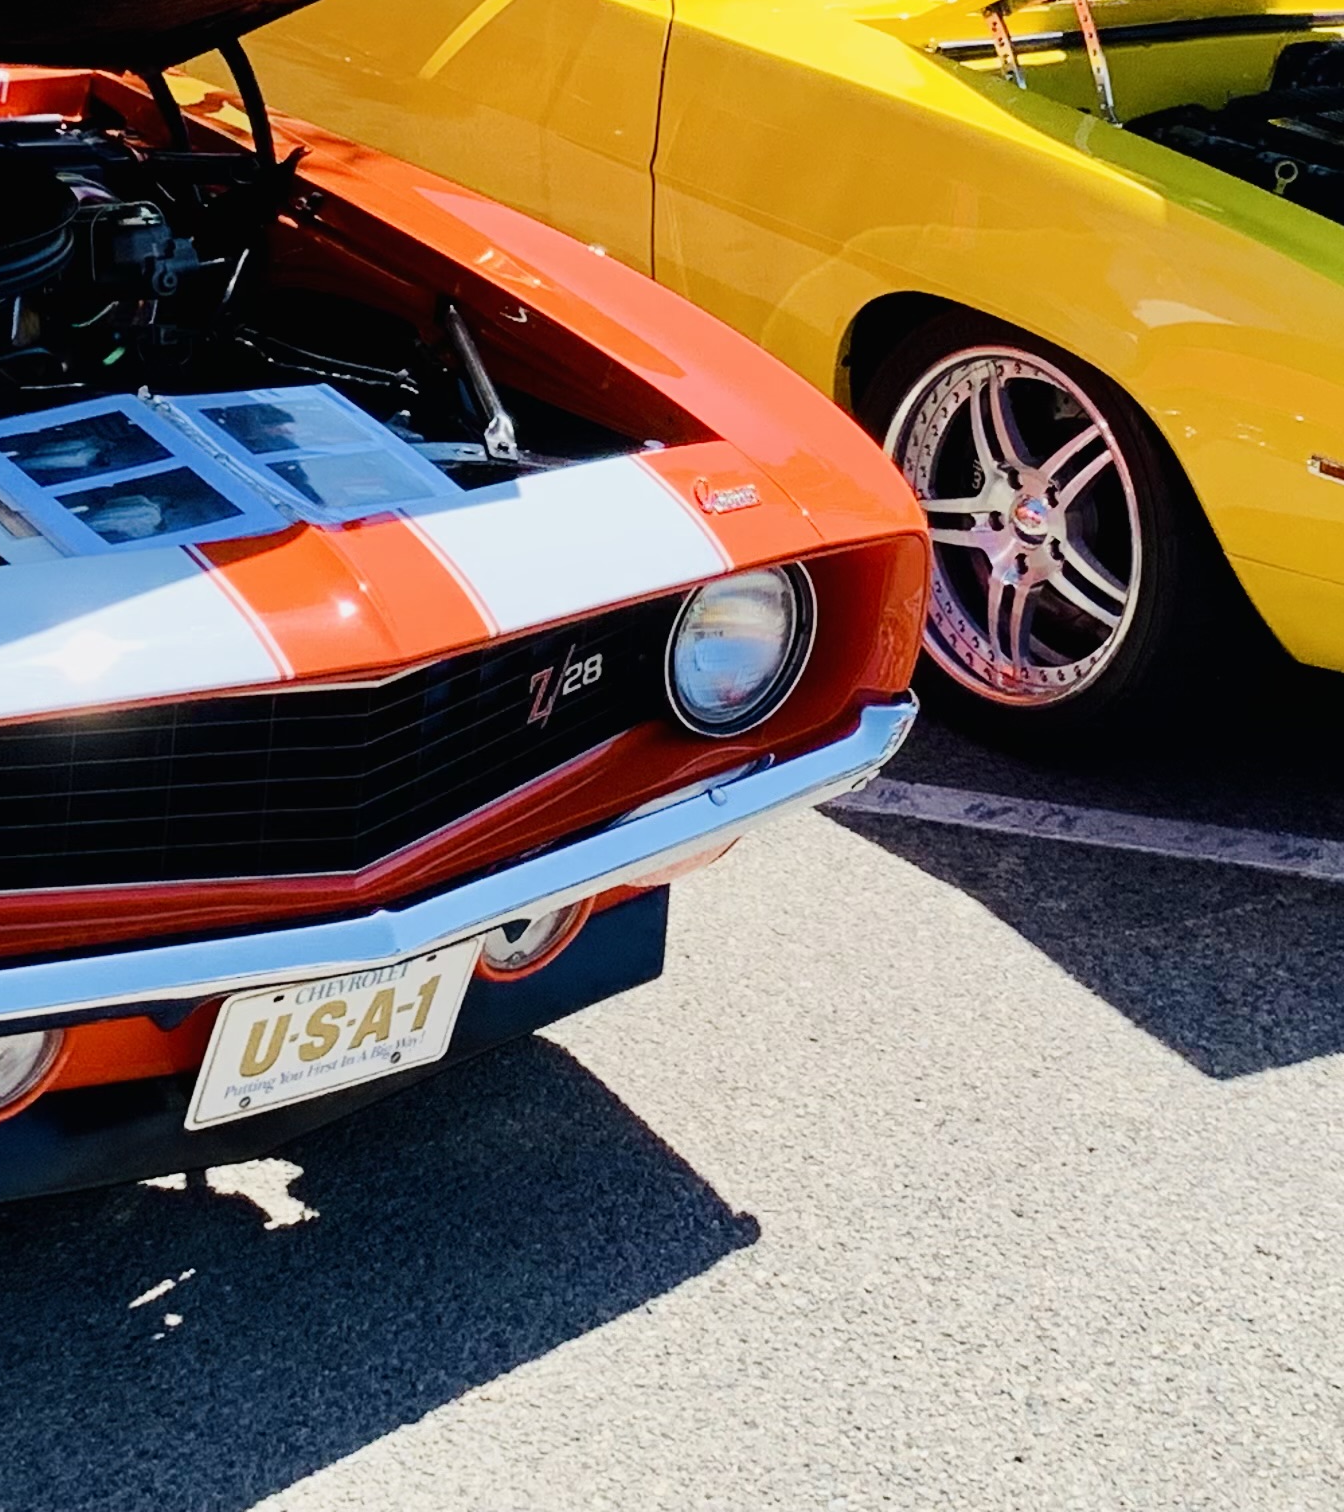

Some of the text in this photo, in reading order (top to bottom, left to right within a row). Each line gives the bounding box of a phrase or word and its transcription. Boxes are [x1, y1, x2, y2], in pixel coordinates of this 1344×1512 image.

[294, 961, 410, 1005] CHEVROLET
[223, 1076, 277, 1100] Putting
[279, 1068, 305, 1086] You
[306, 1059, 338, 1079] First
[338, 1055, 357, 1070] In
[356, 1050, 369, 1065] A
